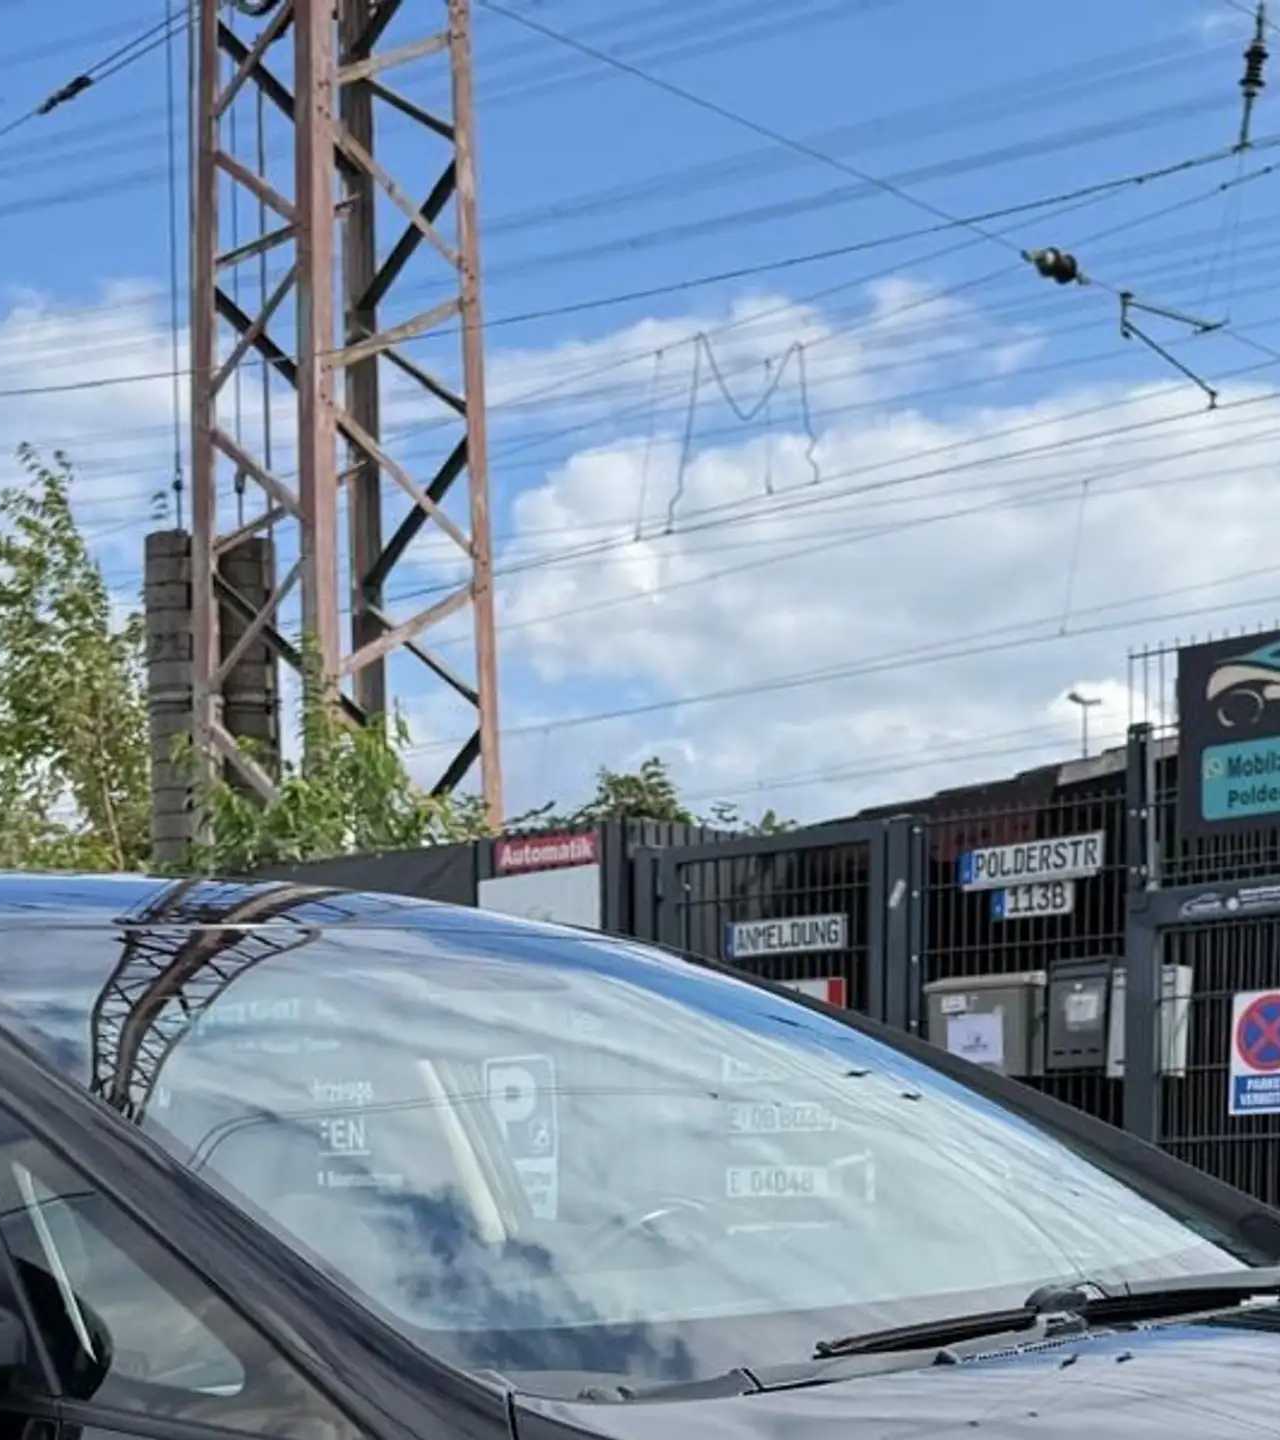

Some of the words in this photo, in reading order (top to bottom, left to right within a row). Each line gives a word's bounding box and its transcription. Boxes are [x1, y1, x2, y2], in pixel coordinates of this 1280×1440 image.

[500, 837, 596, 868] Automatik
[974, 836, 1099, 879] POLDERSTR
[1007, 881, 1066, 913] 113B
[735, 919, 841, 952] ANMELDUNG
